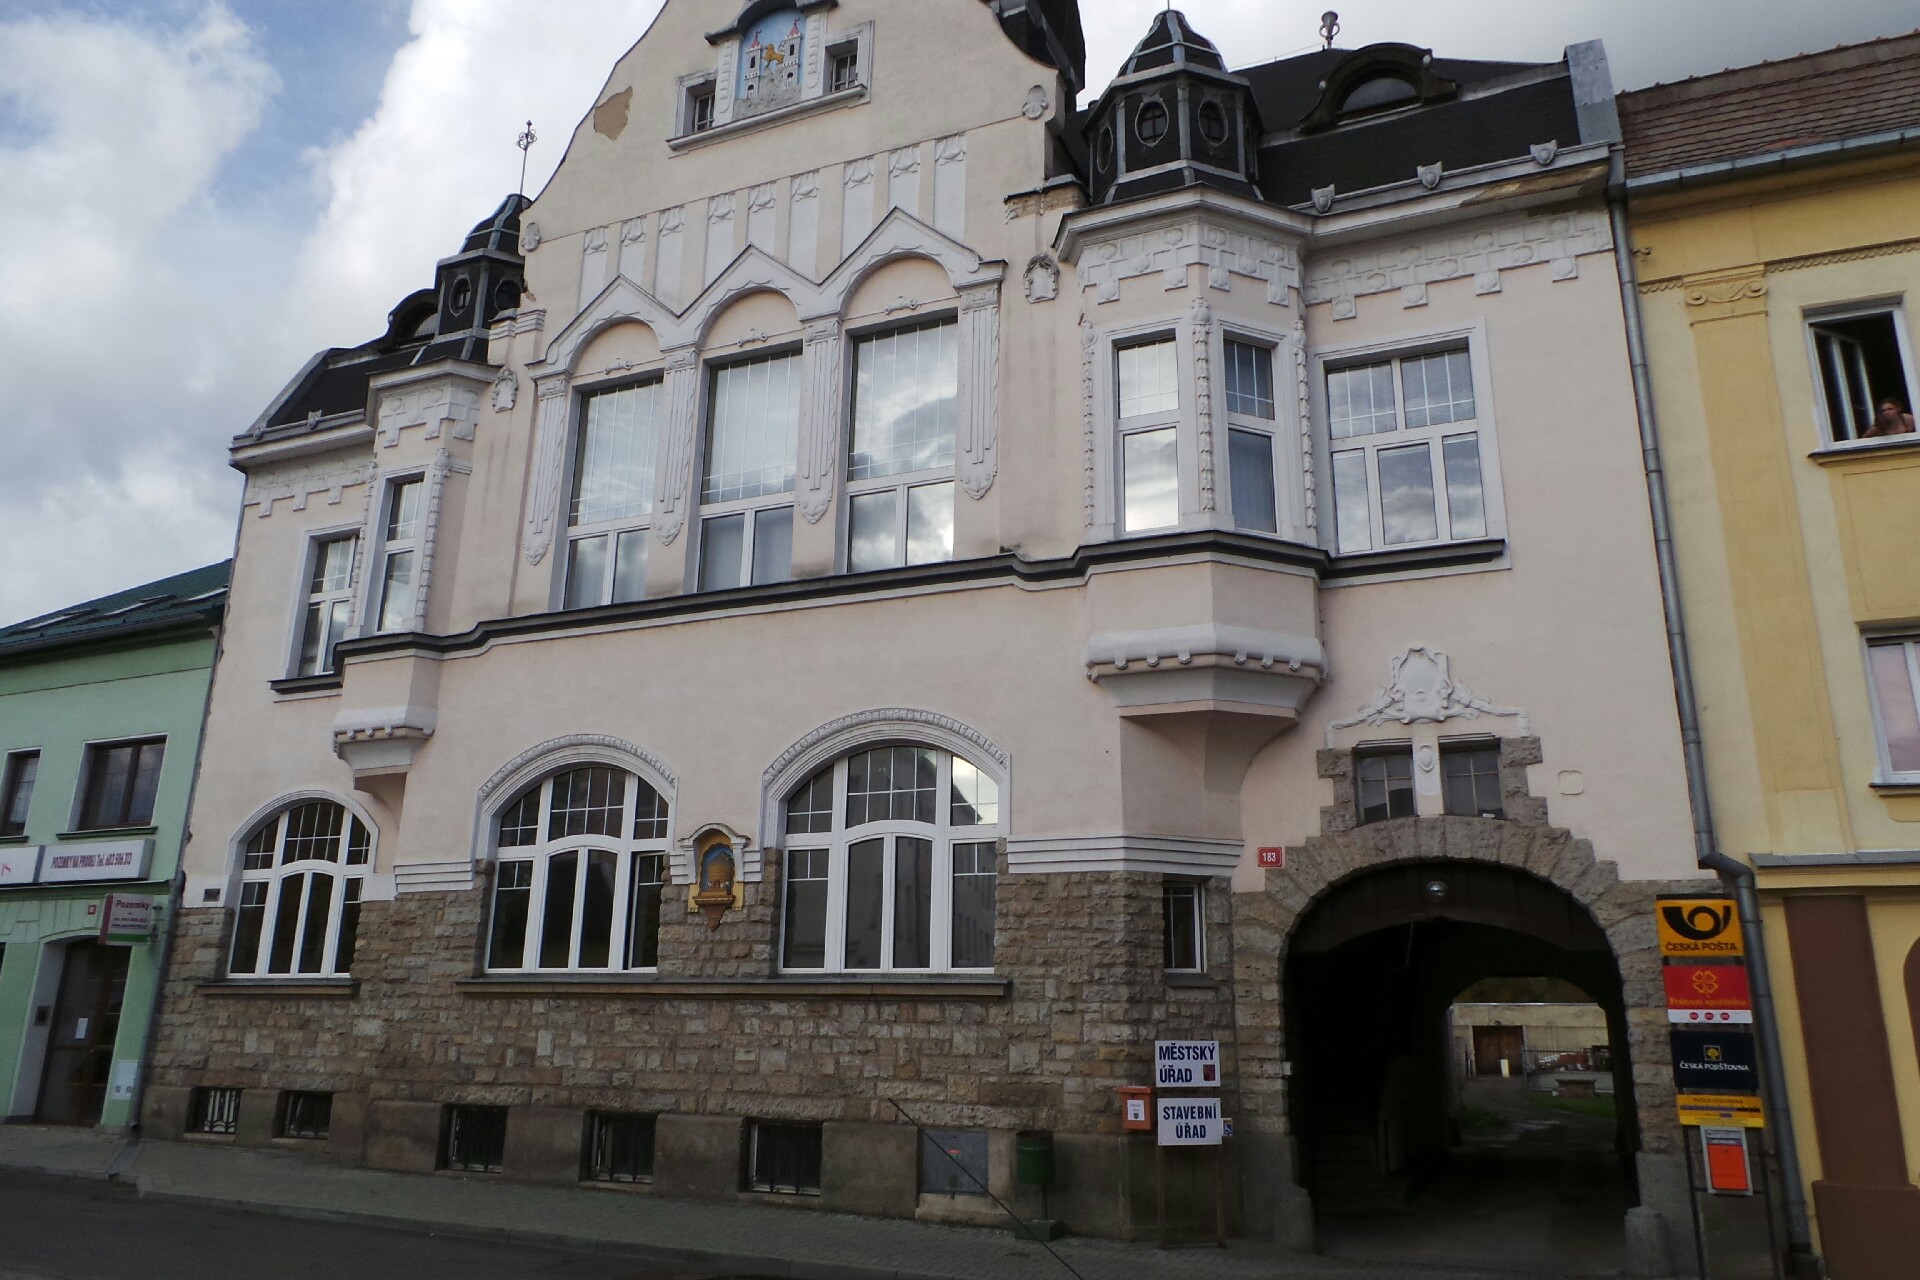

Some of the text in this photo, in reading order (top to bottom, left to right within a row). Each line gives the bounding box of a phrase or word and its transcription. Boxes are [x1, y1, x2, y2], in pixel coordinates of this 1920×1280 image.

[1262, 852, 1276, 862] 183
[116, 899, 150, 910] Pozemky
[1665, 941, 1737, 951] ČESKÁ POŠTA
[1158, 1042, 1216, 1061] MĚSTSKÝ
[1679, 1061, 1750, 1071] ČESKÁ POJIŠŤOVNA
[1159, 1064, 1193, 1083] ÚŘAD
[1163, 1103, 1217, 1120] STAVEBNÍ
[1175, 1122, 1207, 1139] ÚŘAD
